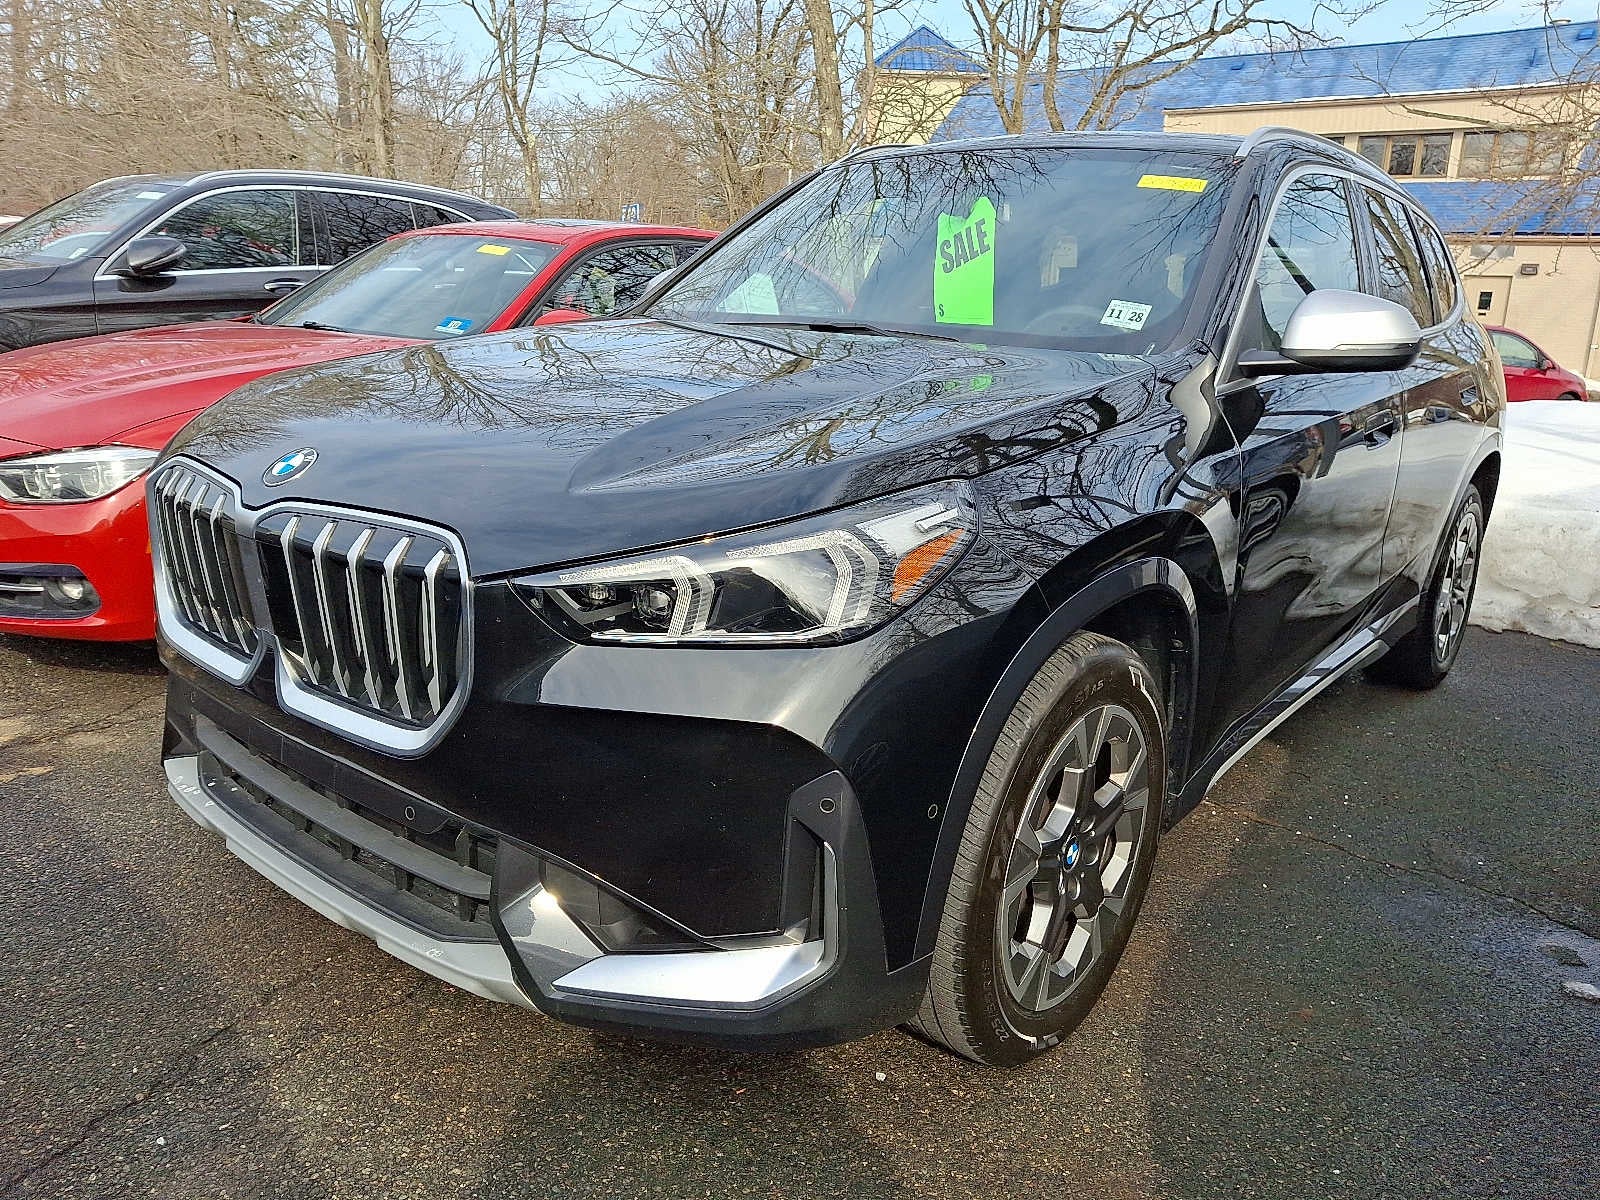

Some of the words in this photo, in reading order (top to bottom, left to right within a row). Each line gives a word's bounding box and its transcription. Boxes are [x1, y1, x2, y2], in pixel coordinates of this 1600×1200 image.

[940, 218, 990, 273] SALE
[1106, 308, 1122, 319] 11
[1127, 311, 1144, 322] 28
